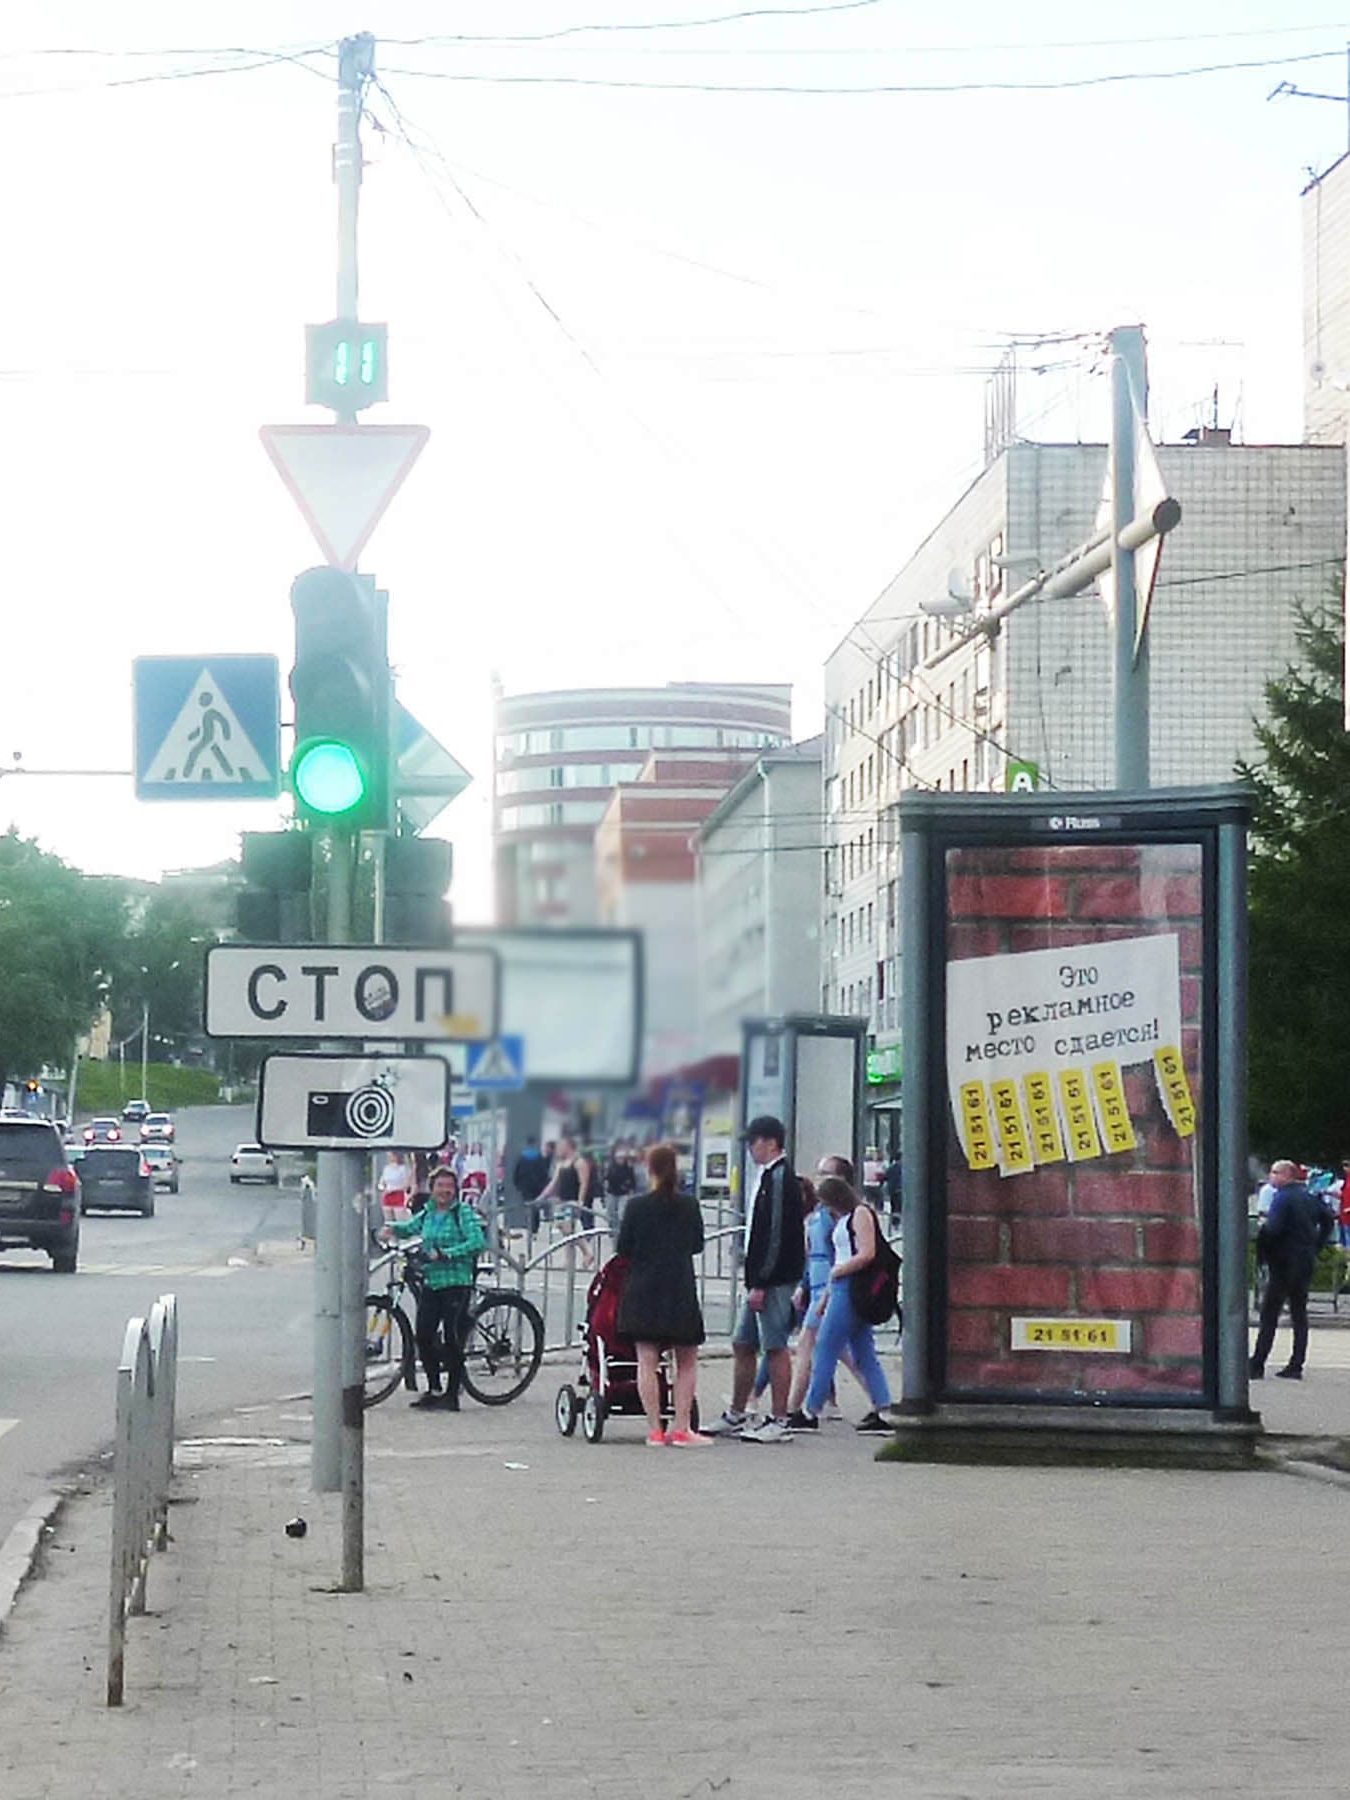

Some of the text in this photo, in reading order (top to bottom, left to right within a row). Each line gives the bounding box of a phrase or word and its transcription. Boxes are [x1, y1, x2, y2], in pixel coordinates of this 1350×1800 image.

[334, 339, 378, 385] 11
[1058, 965, 1099, 989] Это
[247, 963, 454, 1022] СТОП
[986, 990, 1135, 1035] рекламное
[965, 1018, 1160, 1062] место сдается!
[1161, 1055, 1177, 1075] 61
[1031, 1080, 1046, 1100] 61
[1066, 1078, 1080, 1098] 61
[1098, 1071, 1114, 1090] 61
[968, 1088, 979, 1108] 61
[997, 1088, 1012, 1109] 61
[1178, 1107, 1194, 1126] 21
[1040, 1133, 1054, 1152] 21
[1077, 1131, 1091, 1150] 21
[1111, 1123, 1126, 1142] 21
[974, 1141, 988, 1160] 21
[1008, 1141, 1023, 1161] 21
